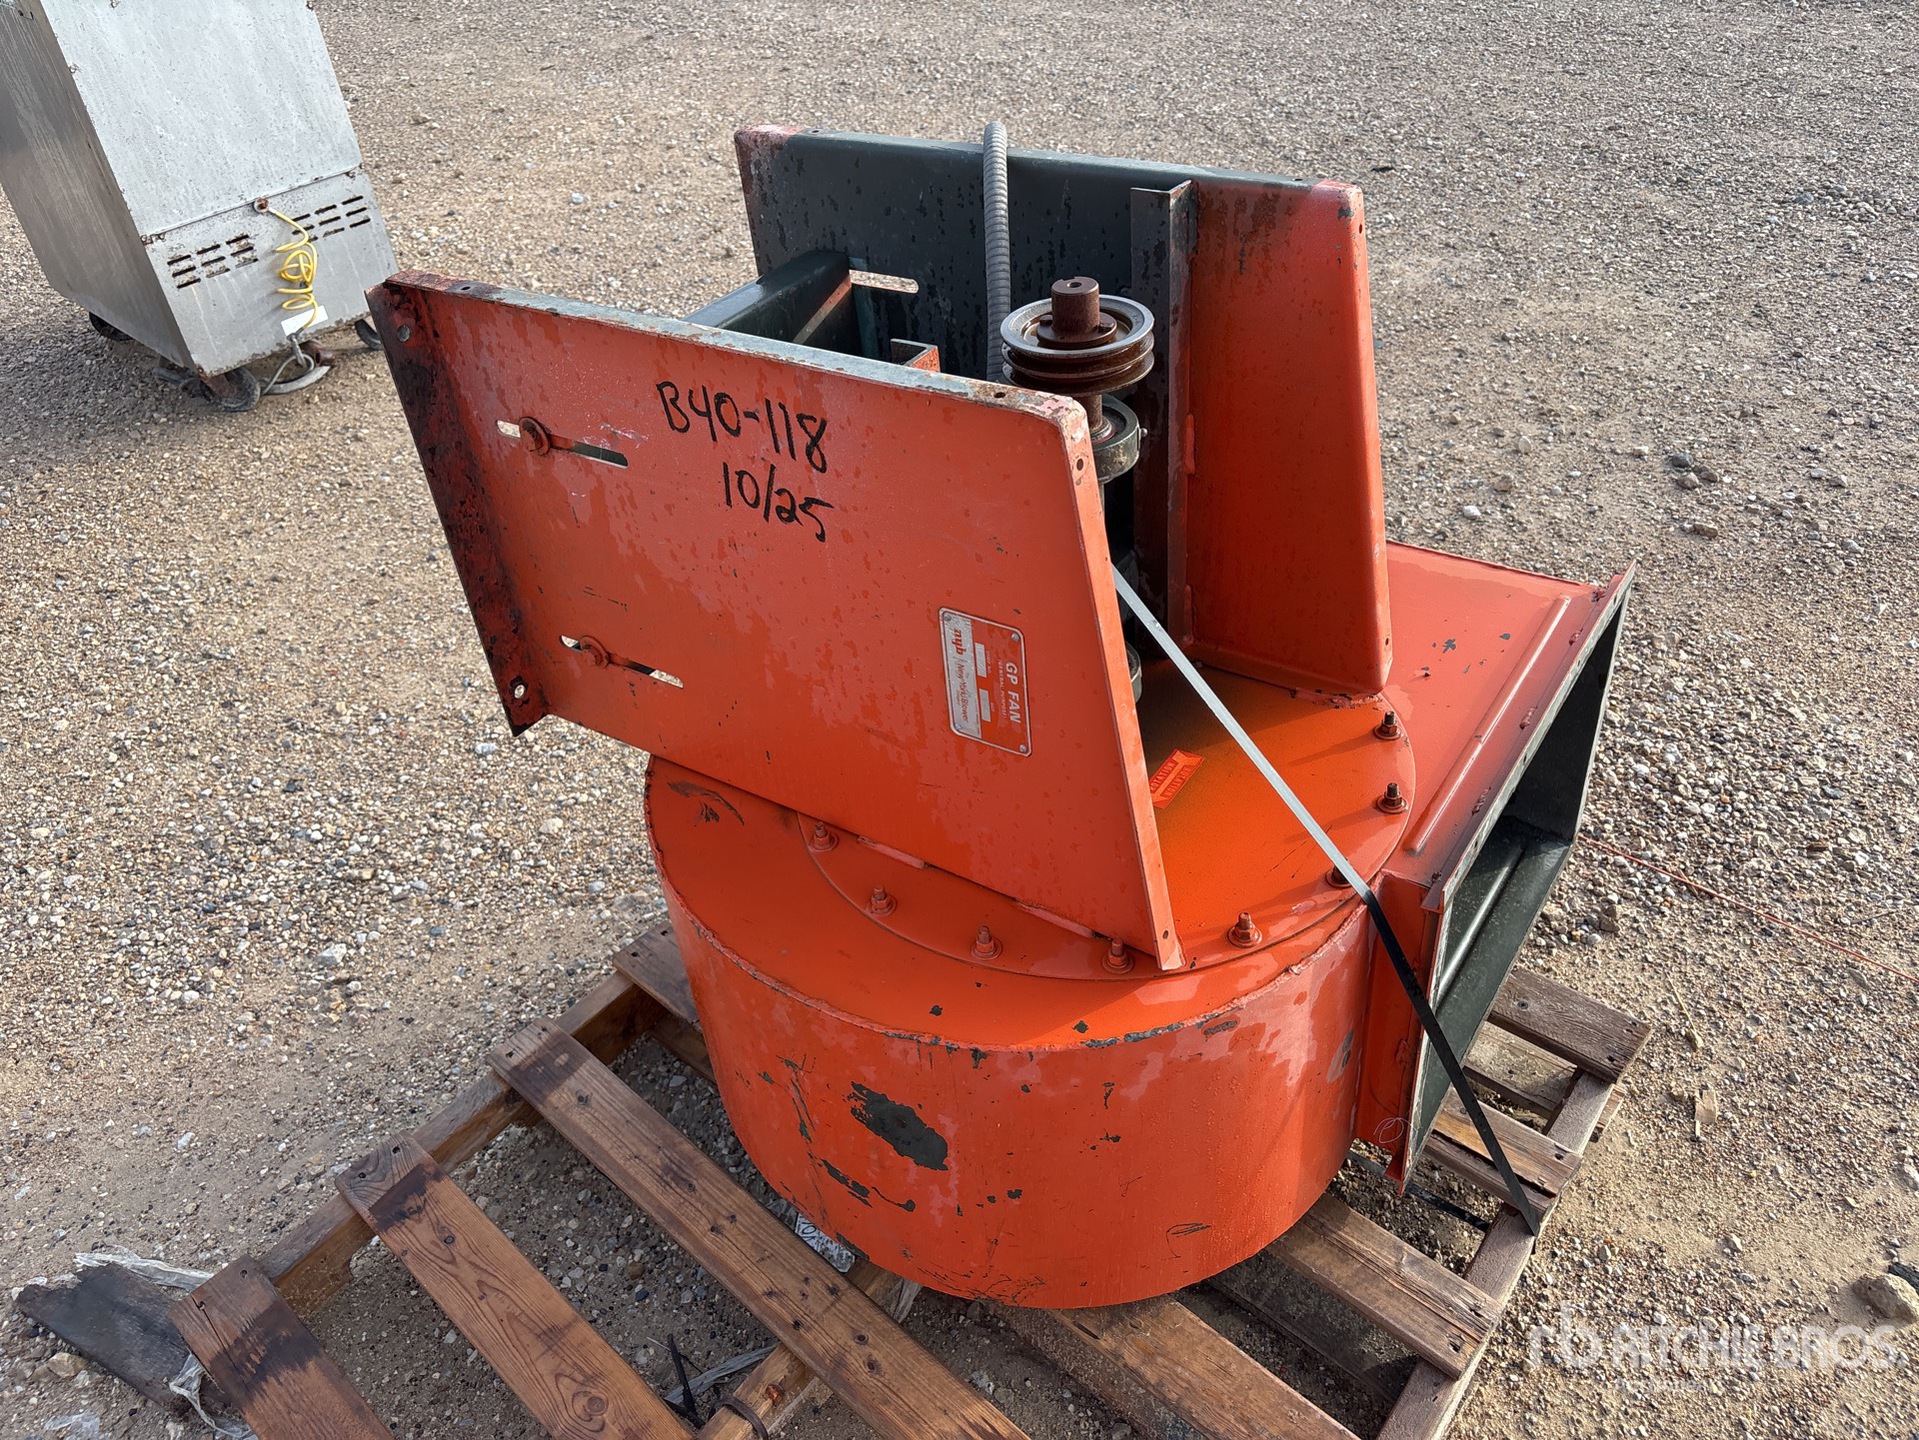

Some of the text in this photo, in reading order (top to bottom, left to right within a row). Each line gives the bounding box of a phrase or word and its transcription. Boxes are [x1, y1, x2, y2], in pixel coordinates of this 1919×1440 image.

[656, 381, 827, 473] B40-118
[722, 461, 834, 542] 10/25
[952, 628, 966, 656] nyb
[956, 663, 970, 723] New York Blower
[1005, 661, 1021, 723] GP FAN
